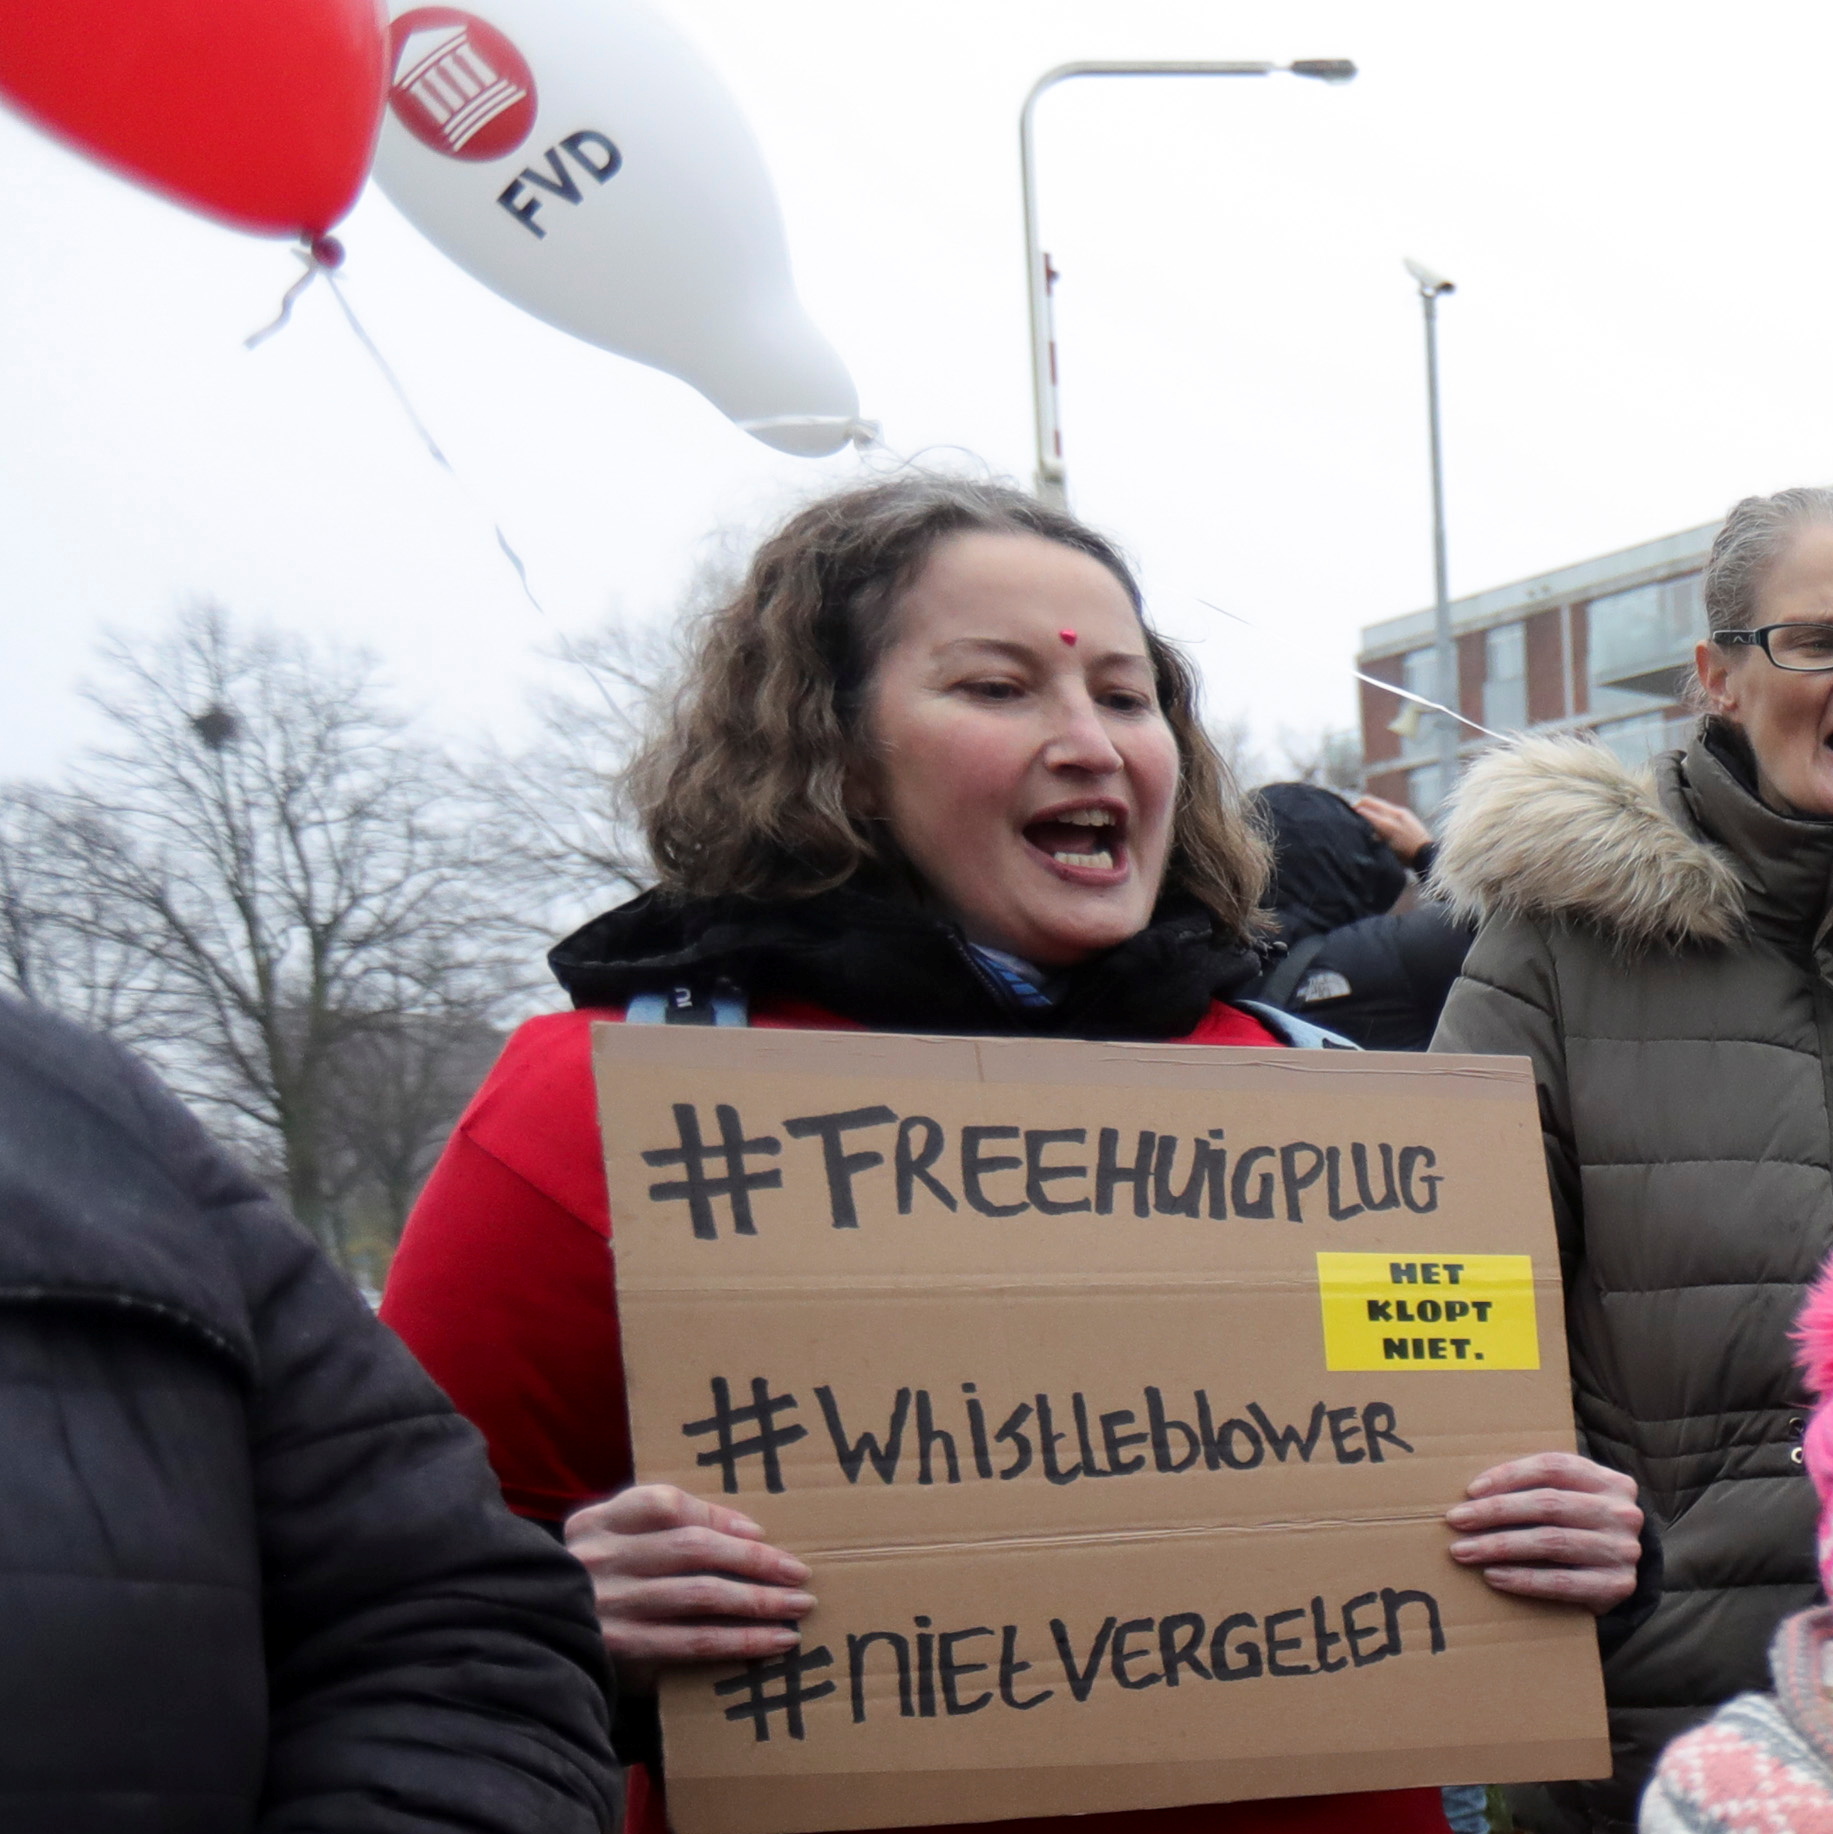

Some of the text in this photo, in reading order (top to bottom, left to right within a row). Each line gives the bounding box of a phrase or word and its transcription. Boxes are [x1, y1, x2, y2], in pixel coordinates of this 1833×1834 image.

[496, 129, 622, 241] FVD
[1390, 1262, 1464, 1285] HET
[1367, 1299, 1493, 1322] KLOPT
[1383, 1337, 1485, 1360] NIET.
